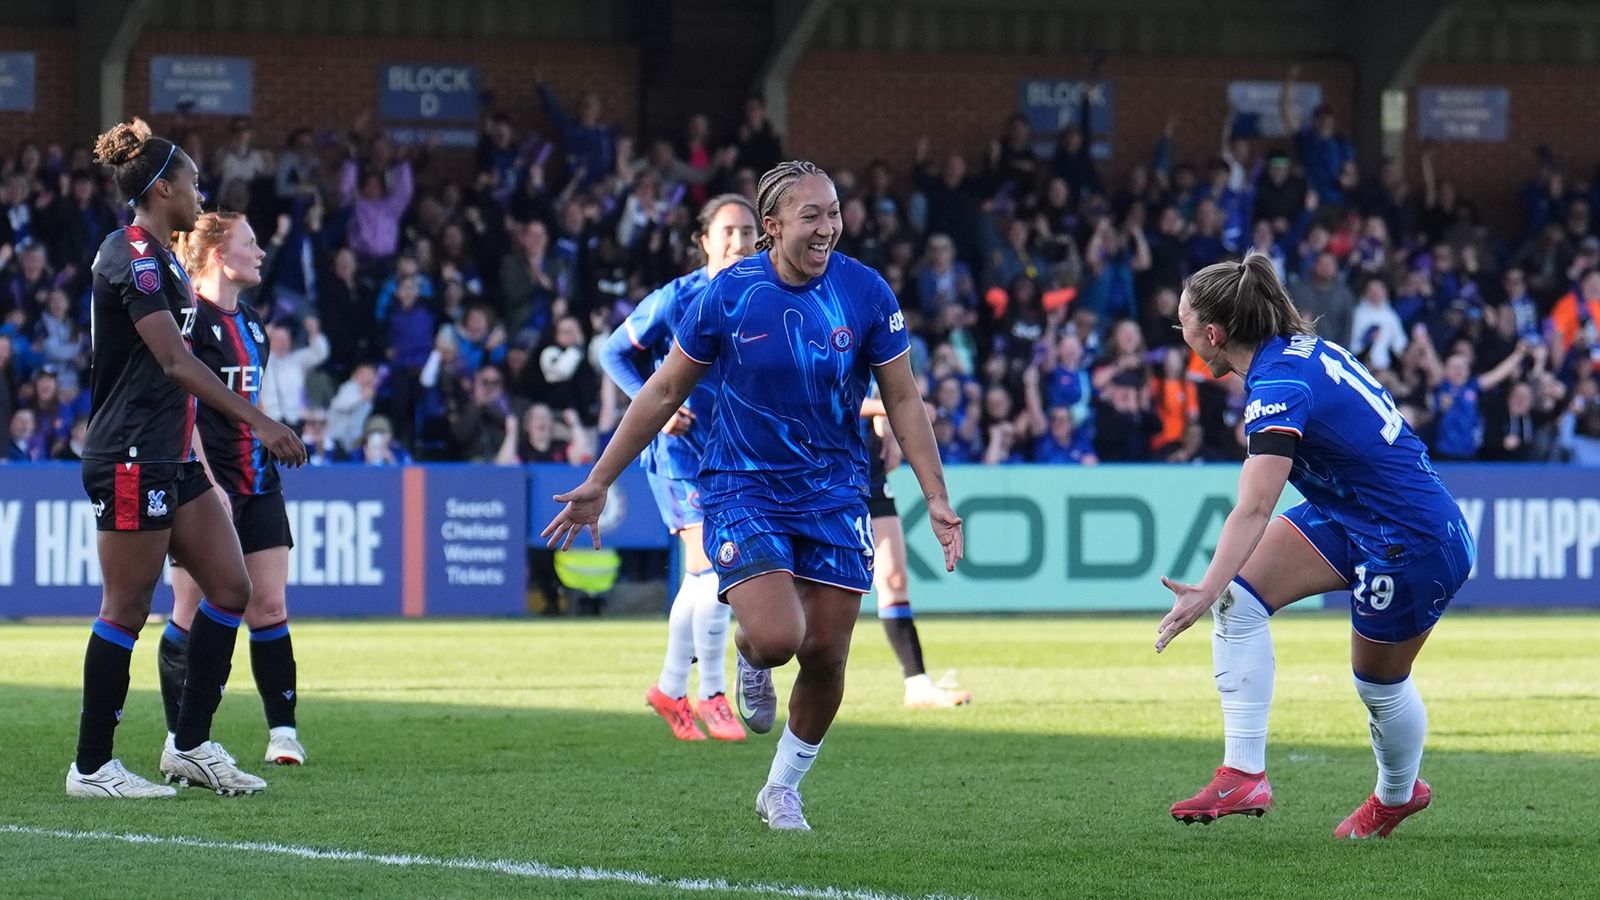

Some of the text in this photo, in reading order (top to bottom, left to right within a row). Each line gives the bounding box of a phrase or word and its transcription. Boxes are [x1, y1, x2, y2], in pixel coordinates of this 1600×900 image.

[388, 67, 470, 92] BLOCK
[420, 93, 439, 117] D
[445, 498, 505, 518] Search
[441, 522, 509, 540] Chelsea
[905, 494, 1238, 581] KODA
[444, 545, 506, 562] Women
[445, 566, 504, 585] Tickets
[1353, 565, 1395, 611] 19
